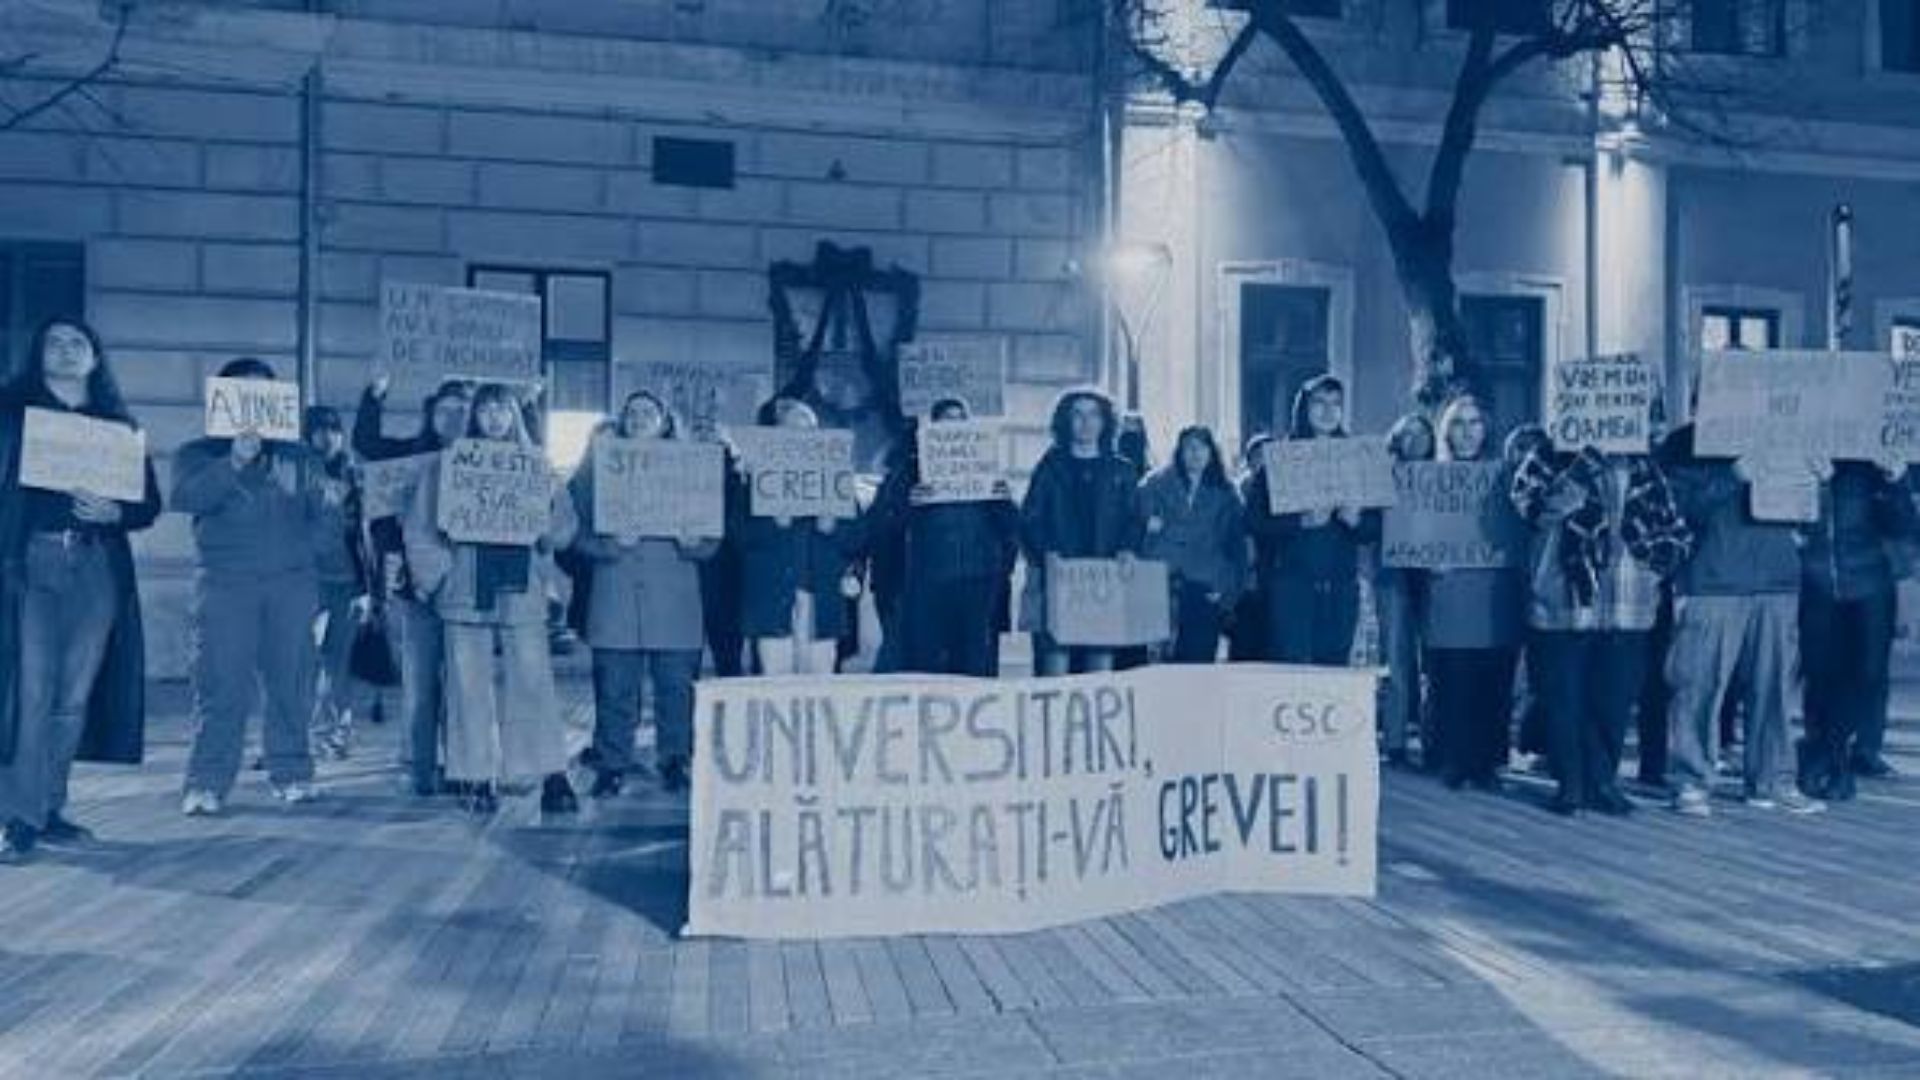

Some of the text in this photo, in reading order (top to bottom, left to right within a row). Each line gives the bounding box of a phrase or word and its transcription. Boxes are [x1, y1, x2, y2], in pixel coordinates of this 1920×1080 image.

[711, 686, 1153, 785] UNIVERSITARI,
[1274, 702, 1341, 736] CSC
[707, 783, 1130, 900] ALĂTURAȚI-VĂ
